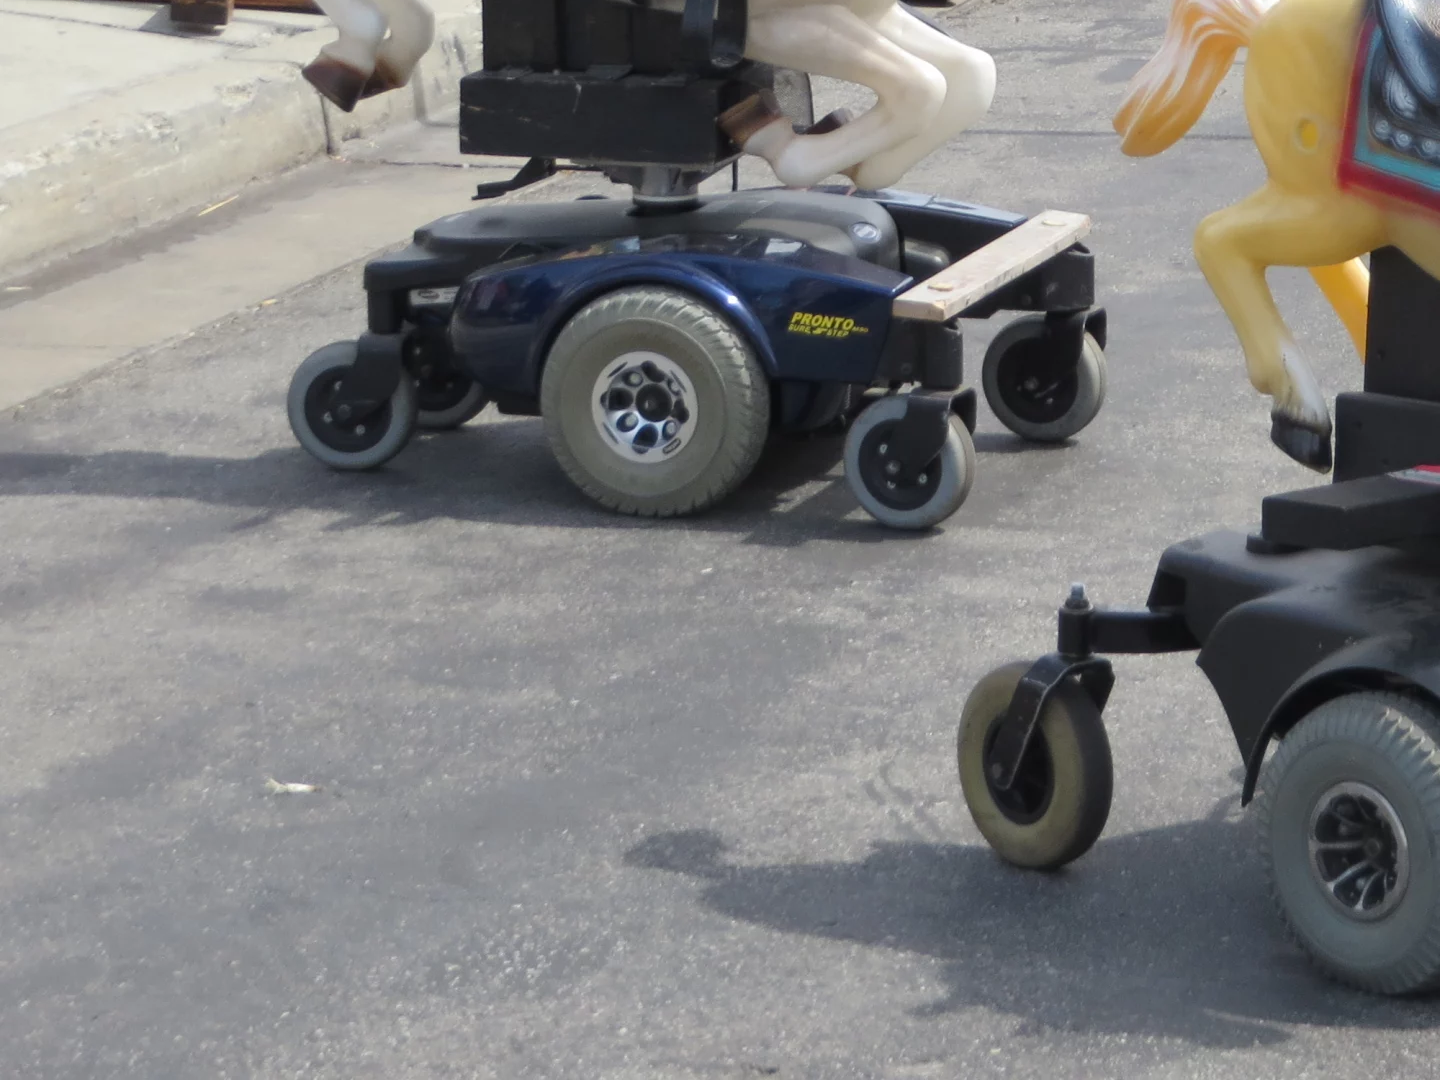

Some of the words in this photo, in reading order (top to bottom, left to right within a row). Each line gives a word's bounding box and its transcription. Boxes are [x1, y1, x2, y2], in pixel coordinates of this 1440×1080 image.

[791, 311, 854, 331] PRONTO
[788, 323, 812, 335] SURE
[826, 328, 849, 338] STEP
